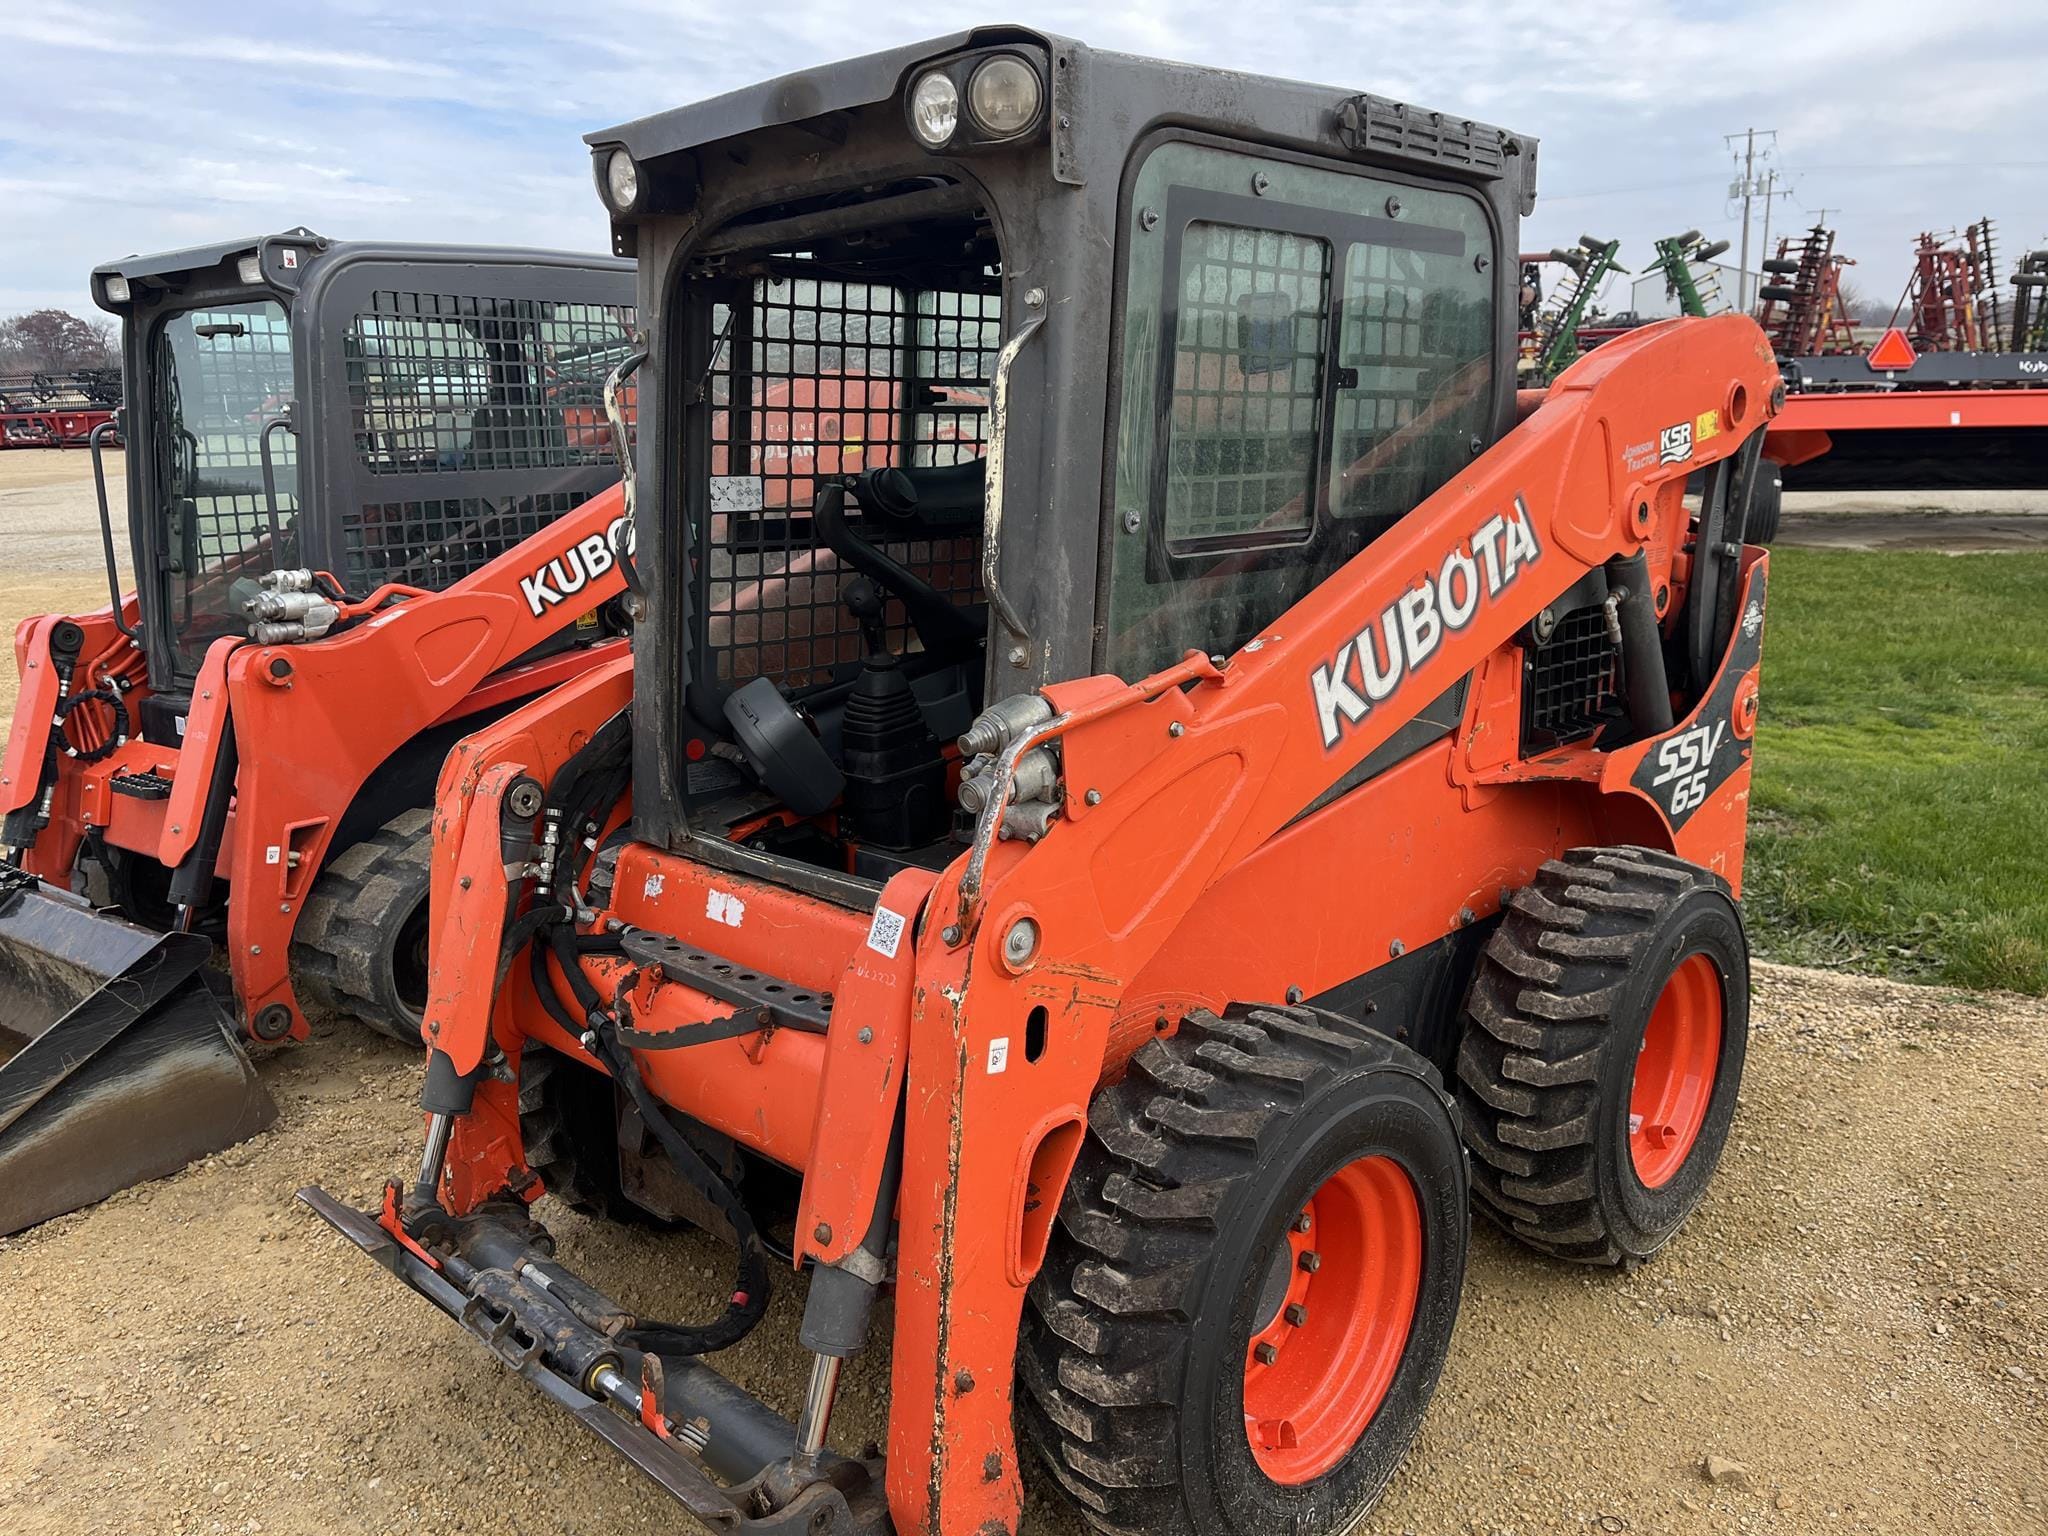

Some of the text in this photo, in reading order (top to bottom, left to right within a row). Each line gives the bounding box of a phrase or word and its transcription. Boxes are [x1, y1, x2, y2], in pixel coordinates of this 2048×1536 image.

[1660, 422, 1691, 452] KSR
[1311, 497, 1540, 749] KUBOTA
[1652, 719, 1727, 788] SSV
[1670, 768, 1709, 816] 65
